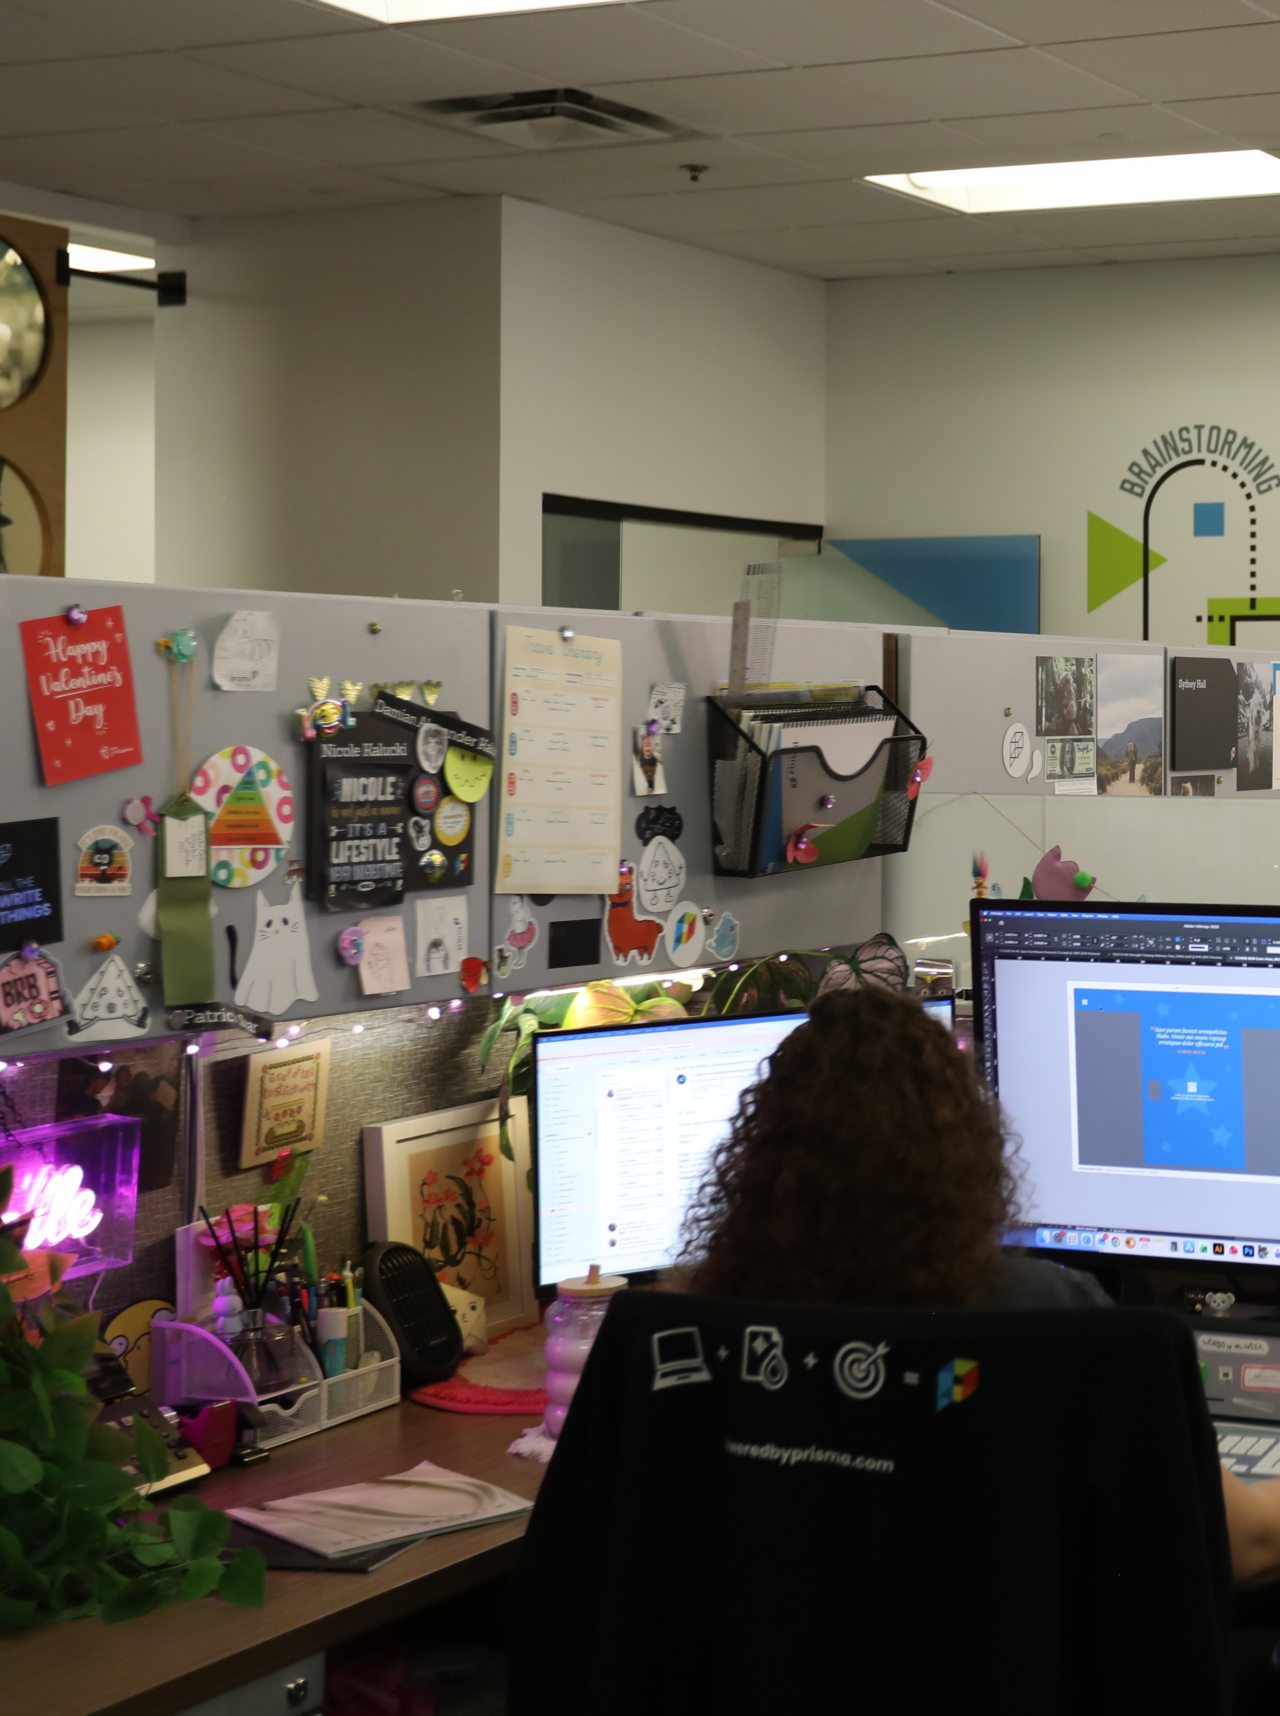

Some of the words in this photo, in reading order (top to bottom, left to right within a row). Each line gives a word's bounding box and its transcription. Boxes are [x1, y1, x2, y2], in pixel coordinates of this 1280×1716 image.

[43, 635, 109, 665] Happy
[1178, 679, 1196, 691] Sydney
[1196, 679, 1207, 689] Hall
[67, 698, 106, 729] Day
[375, 699, 416, 725] Damian
[320, 743, 361, 758] Nicole
[340, 776, 397, 803] NICOLE
[346, 823, 374, 838] IT'S
[378, 822, 388, 837] A
[330, 837, 401, 864] LIFESTYLE
[15, 876, 36, 888] THE
[0, 903, 52, 925] THINGS
[1, 973, 40, 1008] BRB
[277, 1067, 293, 1082] cup
[293, 1065, 302, 1078] of
